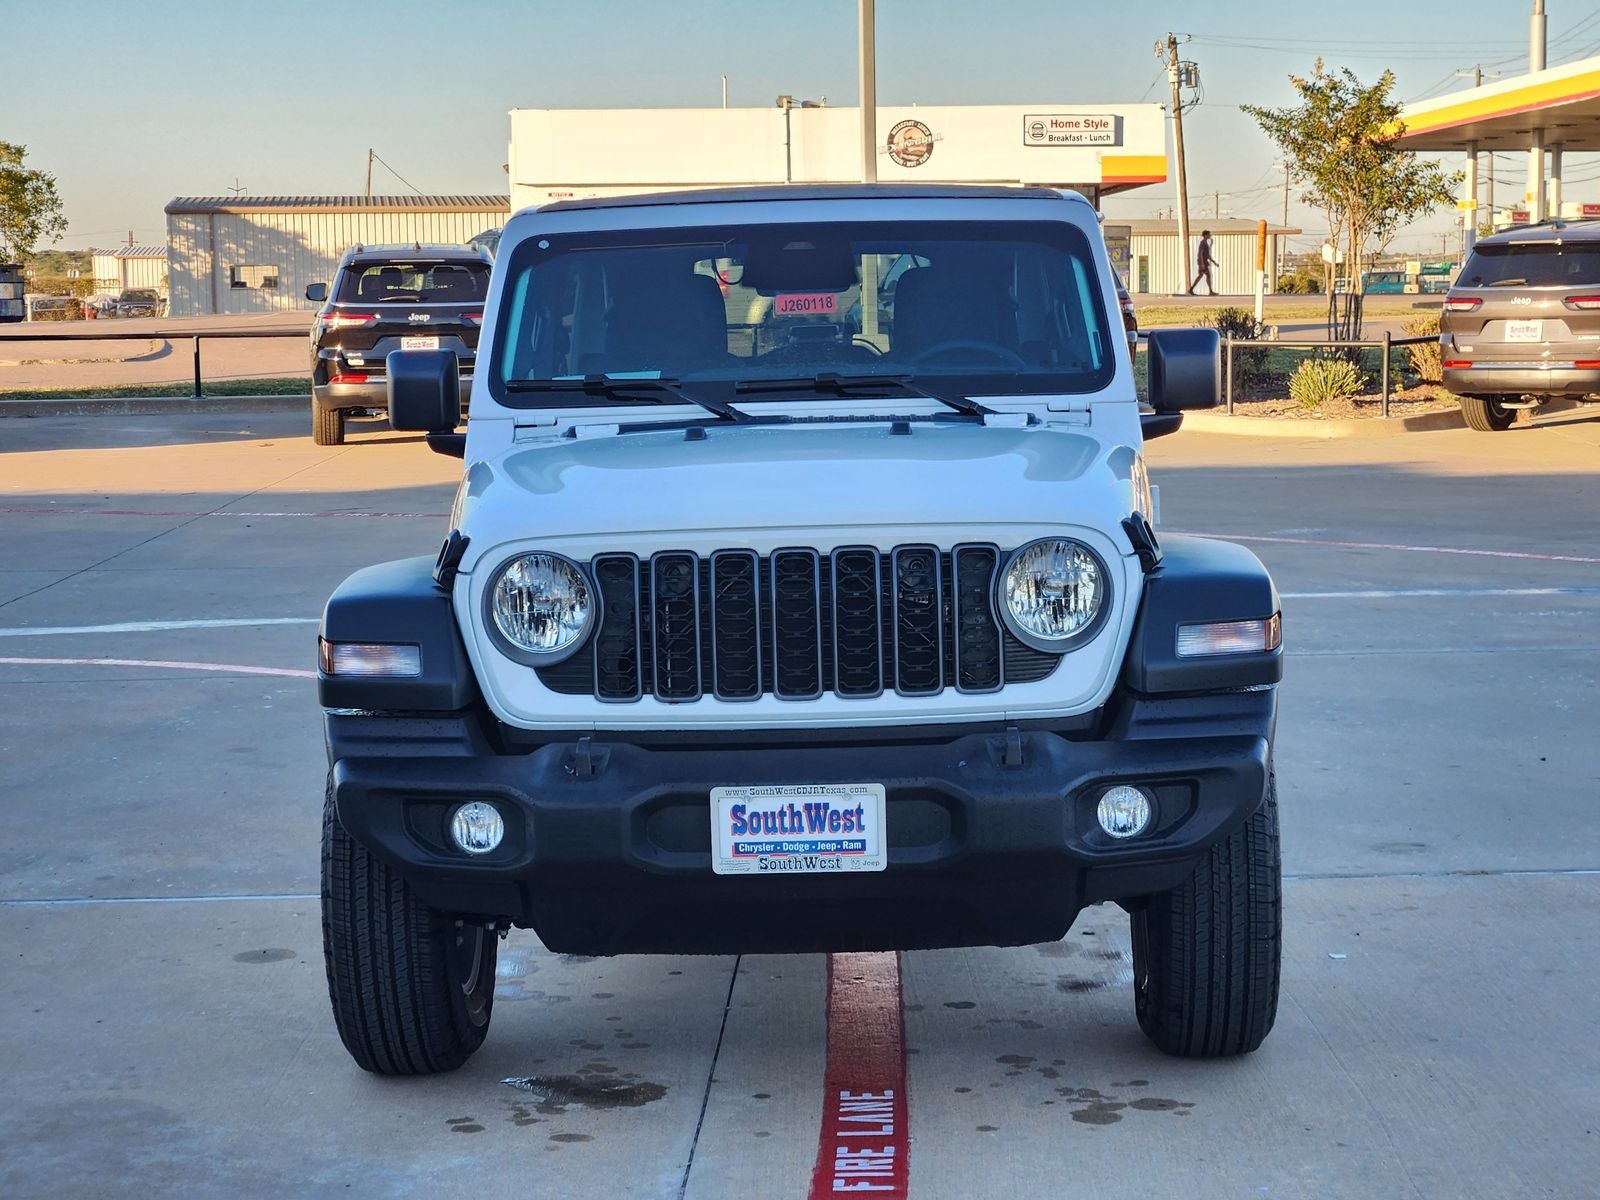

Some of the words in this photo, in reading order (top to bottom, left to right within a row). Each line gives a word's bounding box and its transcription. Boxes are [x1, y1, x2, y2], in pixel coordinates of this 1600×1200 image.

[1050, 119, 1081, 129] Home
[1083, 119, 1109, 130] Style
[1048, 134, 1083, 142] Breakfast
[1089, 134, 1111, 142] Lunch
[781, 296, 833, 313] J260118
[1510, 297, 1532, 305] Jeep
[408, 313, 431, 322] Jeep
[724, 786, 868, 797] wwwSouthWestCDJRTexascom
[730, 802, 866, 836] SouthWest
[738, 843, 775, 854] Chrysler
[782, 842, 810, 852] Dodge
[816, 840, 837, 851] Jeep
[842, 840, 862, 850] Ram
[759, 855, 842, 871] SouthWest
[836, 1090, 894, 1136] LANE
[833, 1146, 896, 1191] FIRE
